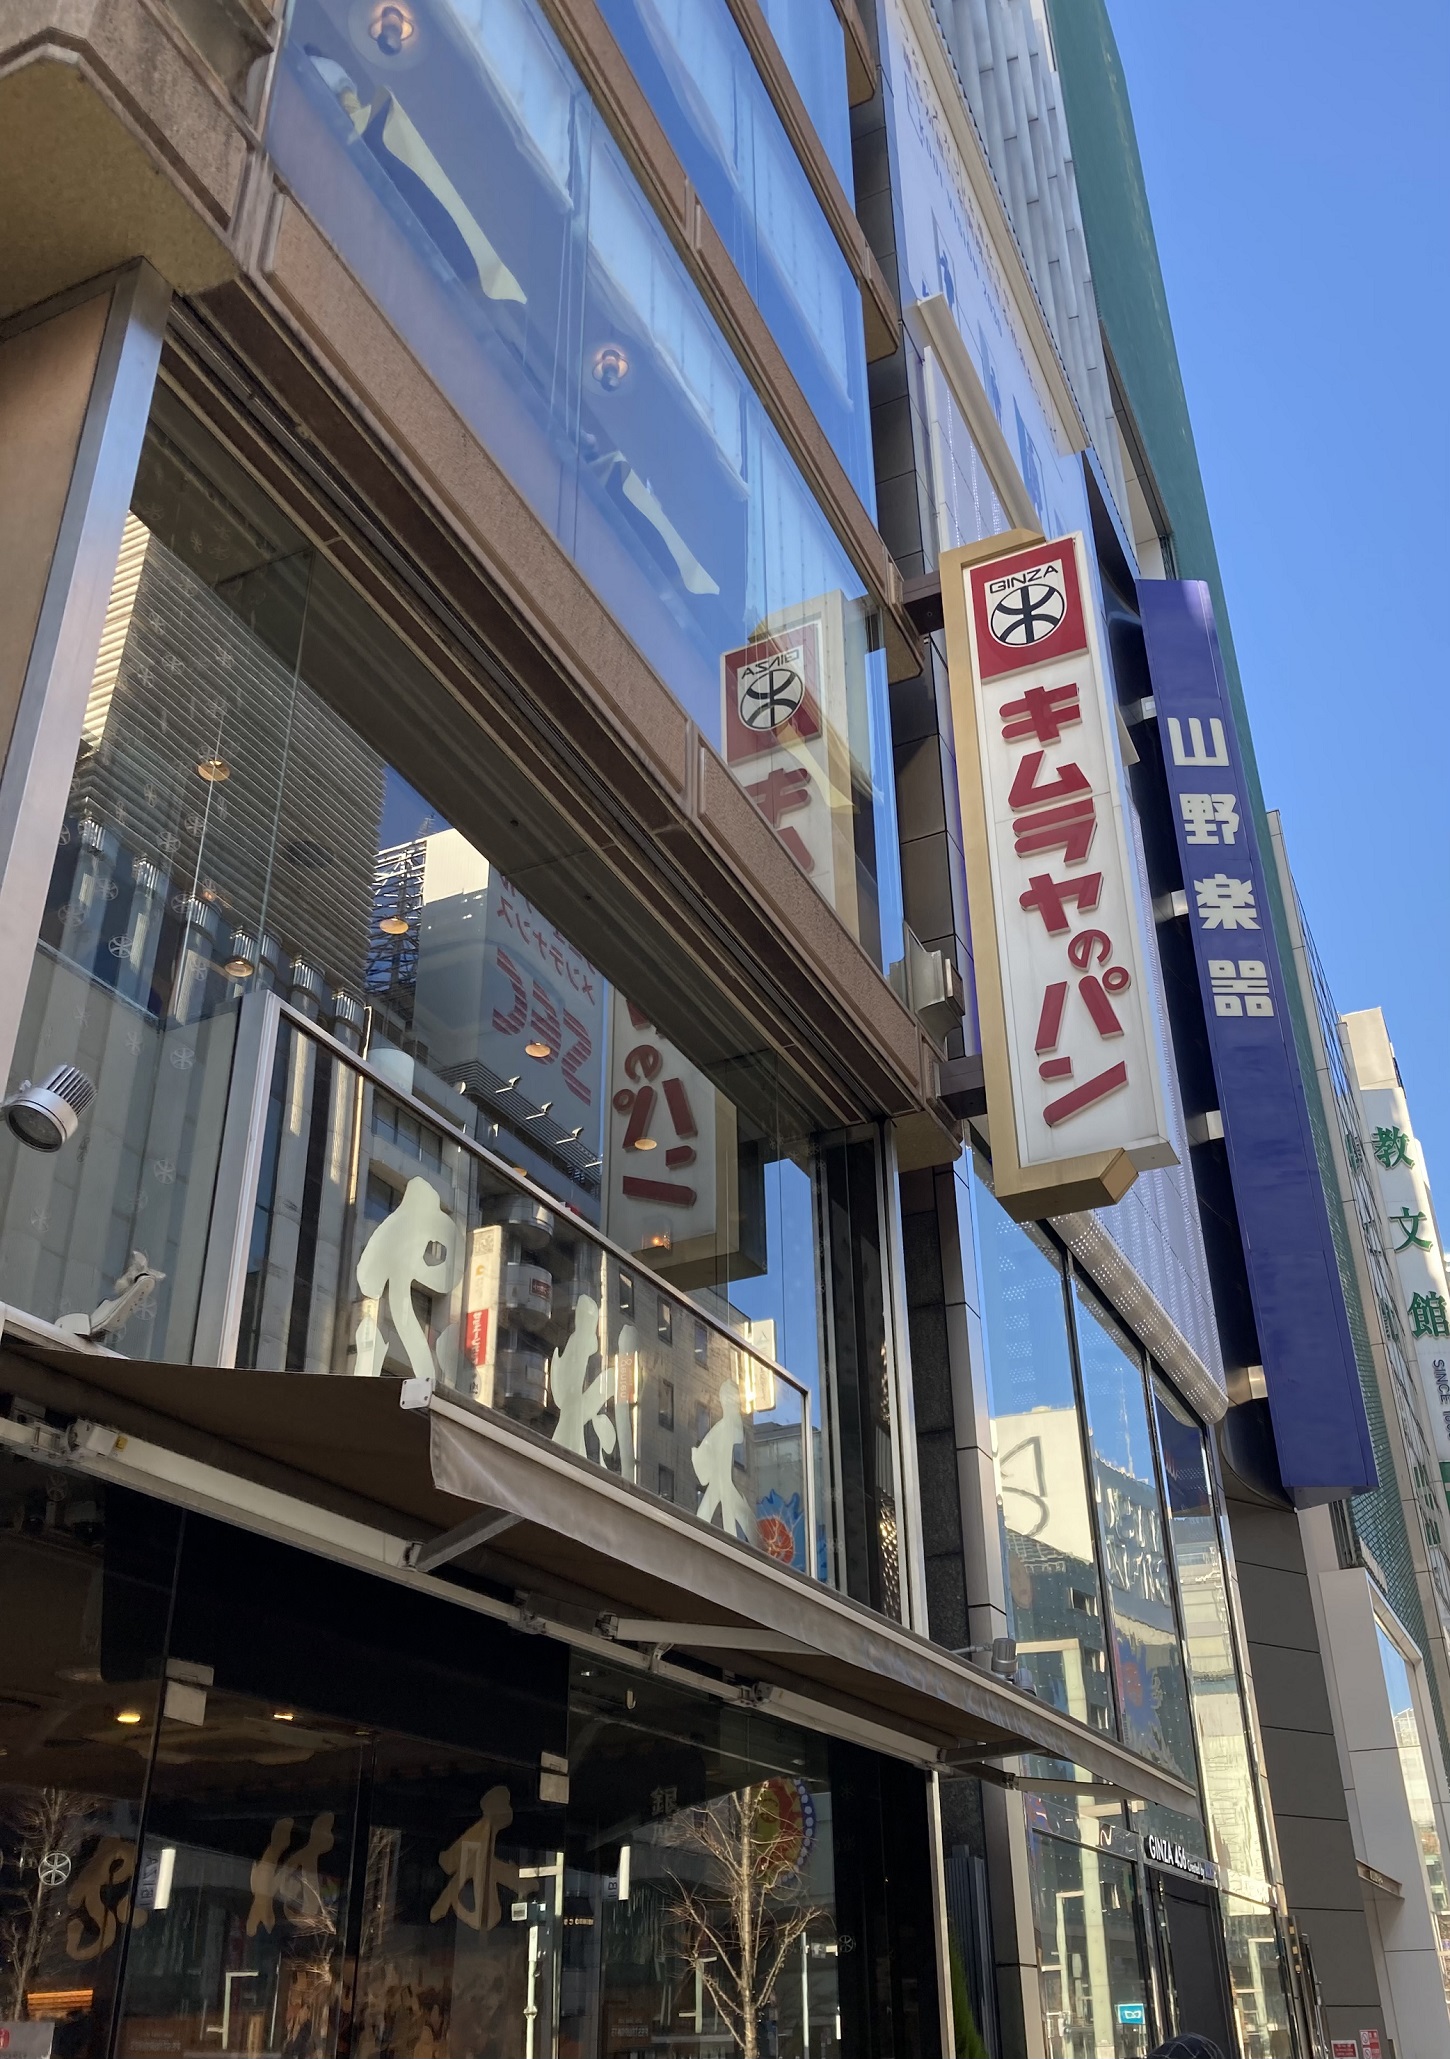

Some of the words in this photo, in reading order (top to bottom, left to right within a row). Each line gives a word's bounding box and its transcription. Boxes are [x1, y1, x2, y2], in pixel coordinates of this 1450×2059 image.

[989, 565, 1059, 595] GINZA
[999, 683, 1131, 1127] キムラヤのパン
[1168, 718, 1274, 1017] 山野楽器
[1371, 1126, 1450, 1339] 教文館
[1149, 1835, 1175, 1866] GINZA
[1175, 1845, 1187, 1870] 456
